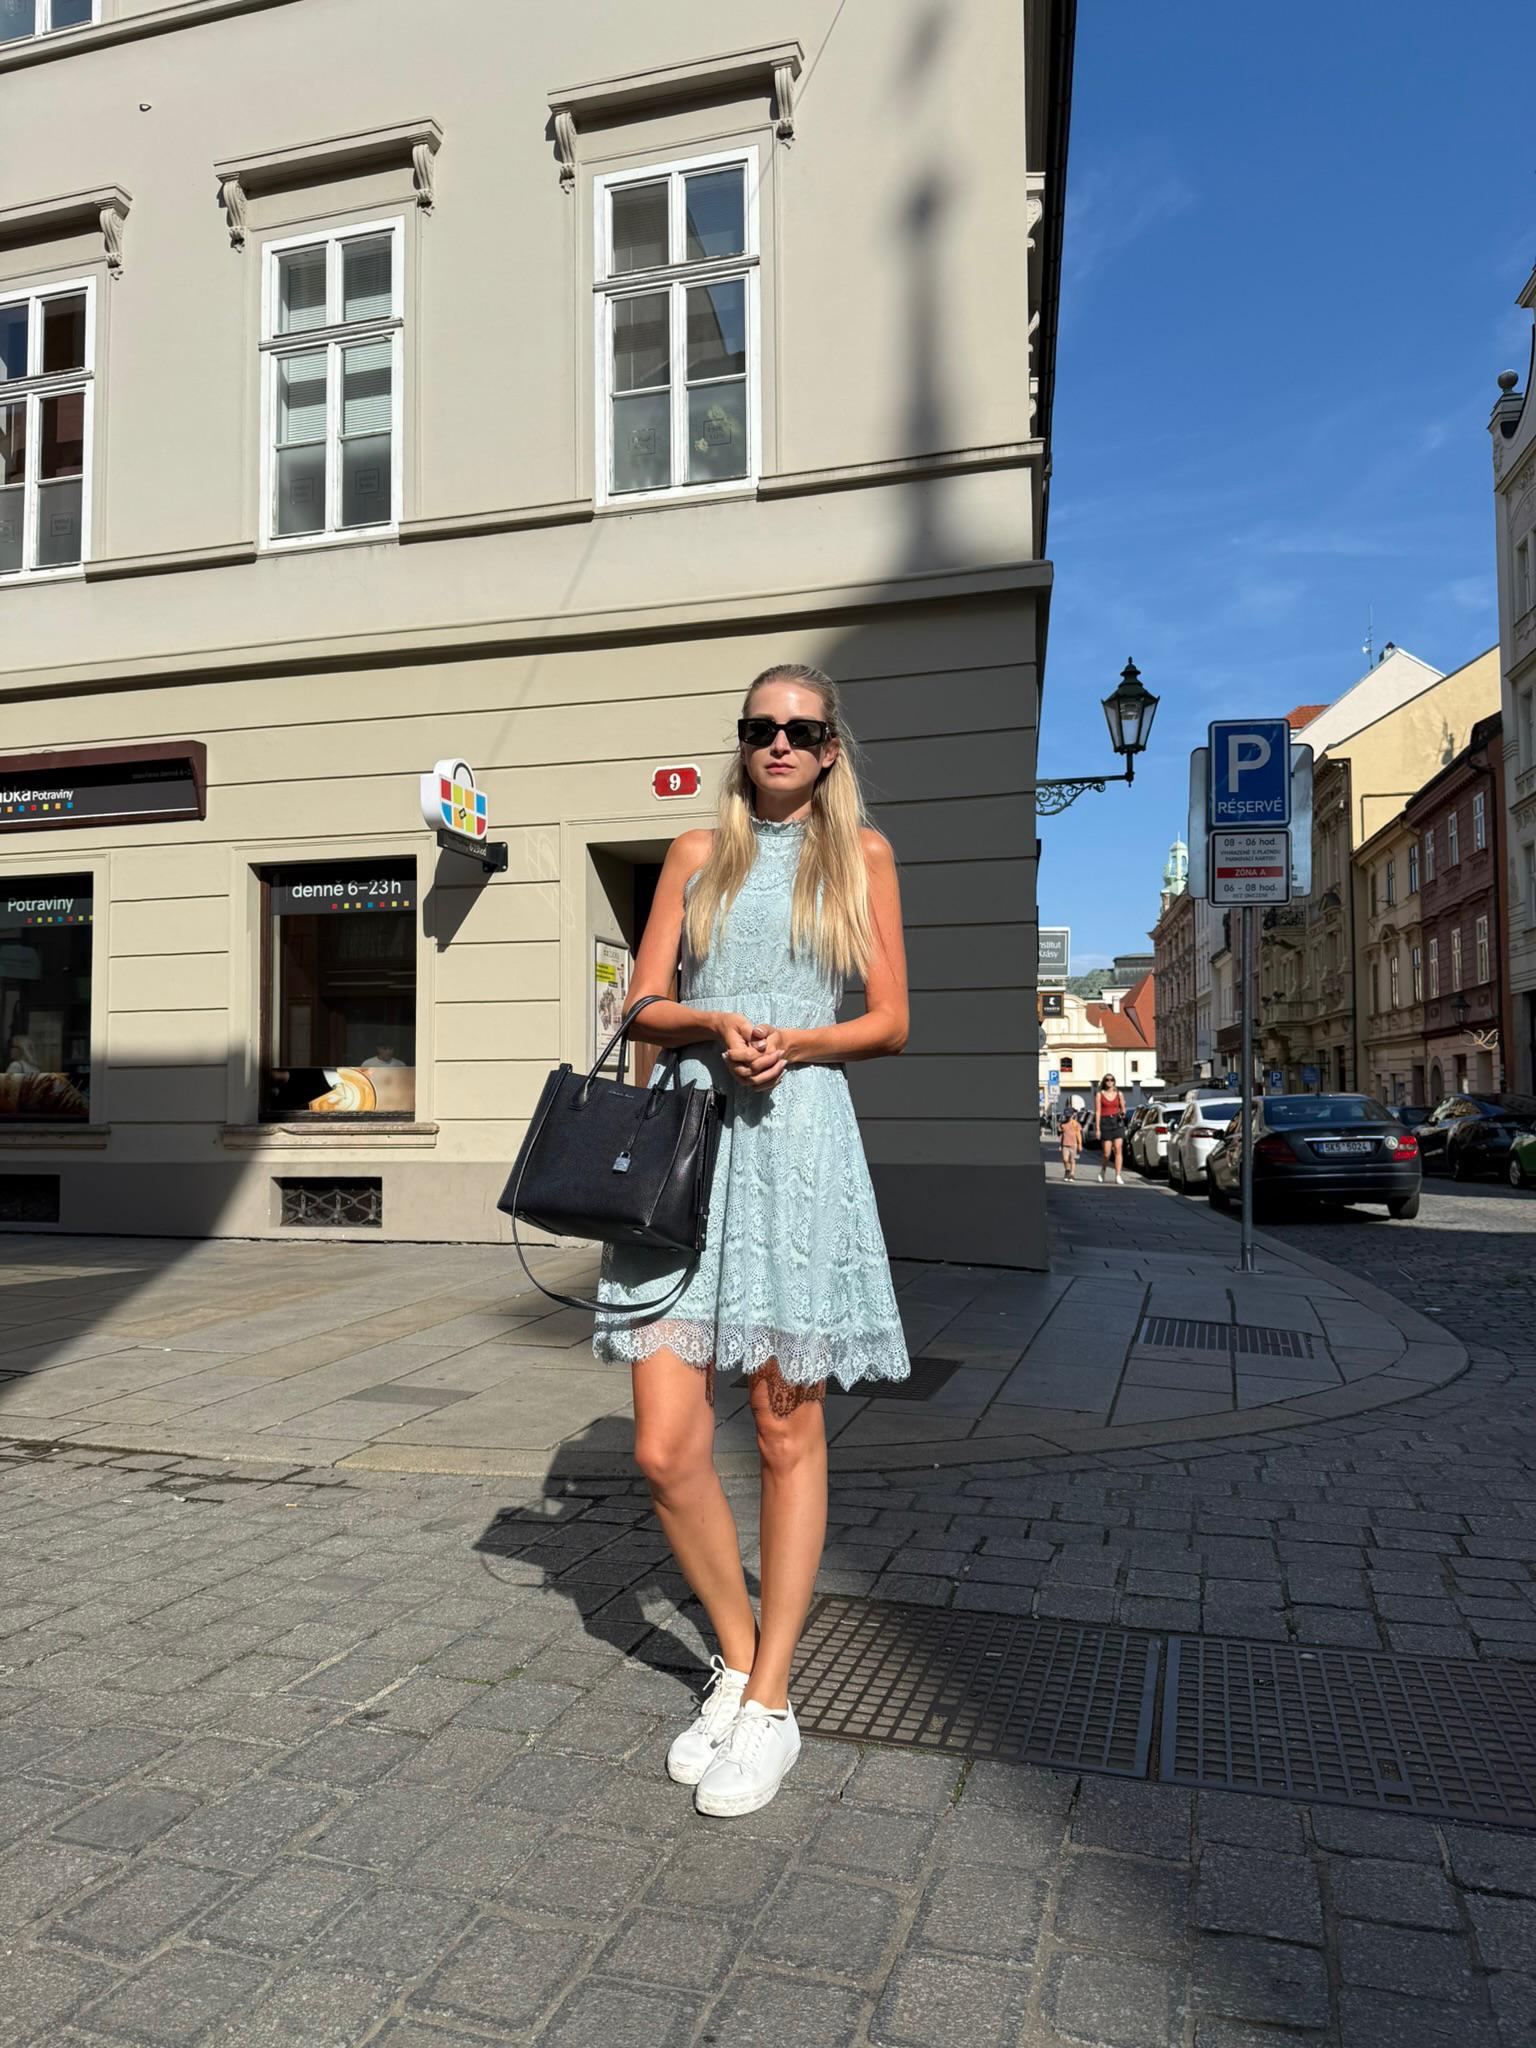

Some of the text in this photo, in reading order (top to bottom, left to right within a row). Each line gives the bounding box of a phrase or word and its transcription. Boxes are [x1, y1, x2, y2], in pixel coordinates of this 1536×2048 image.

[1228, 734, 1272, 793] P
[669, 773, 681, 791] 9
[0, 785, 74, 803] bka Potraviny
[1217, 797, 1283, 814] RÉSERVÉ
[1224, 838, 1235, 847] 08
[1245, 838, 1256, 846] 06
[1260, 868, 1266, 876] A
[292, 880, 344, 898] denně
[1224, 884, 1234, 892] 06
[1245, 884, 1256, 892] 08
[8, 896, 74, 913] Potraviny
[1272, 1072, 1281, 1082] P
